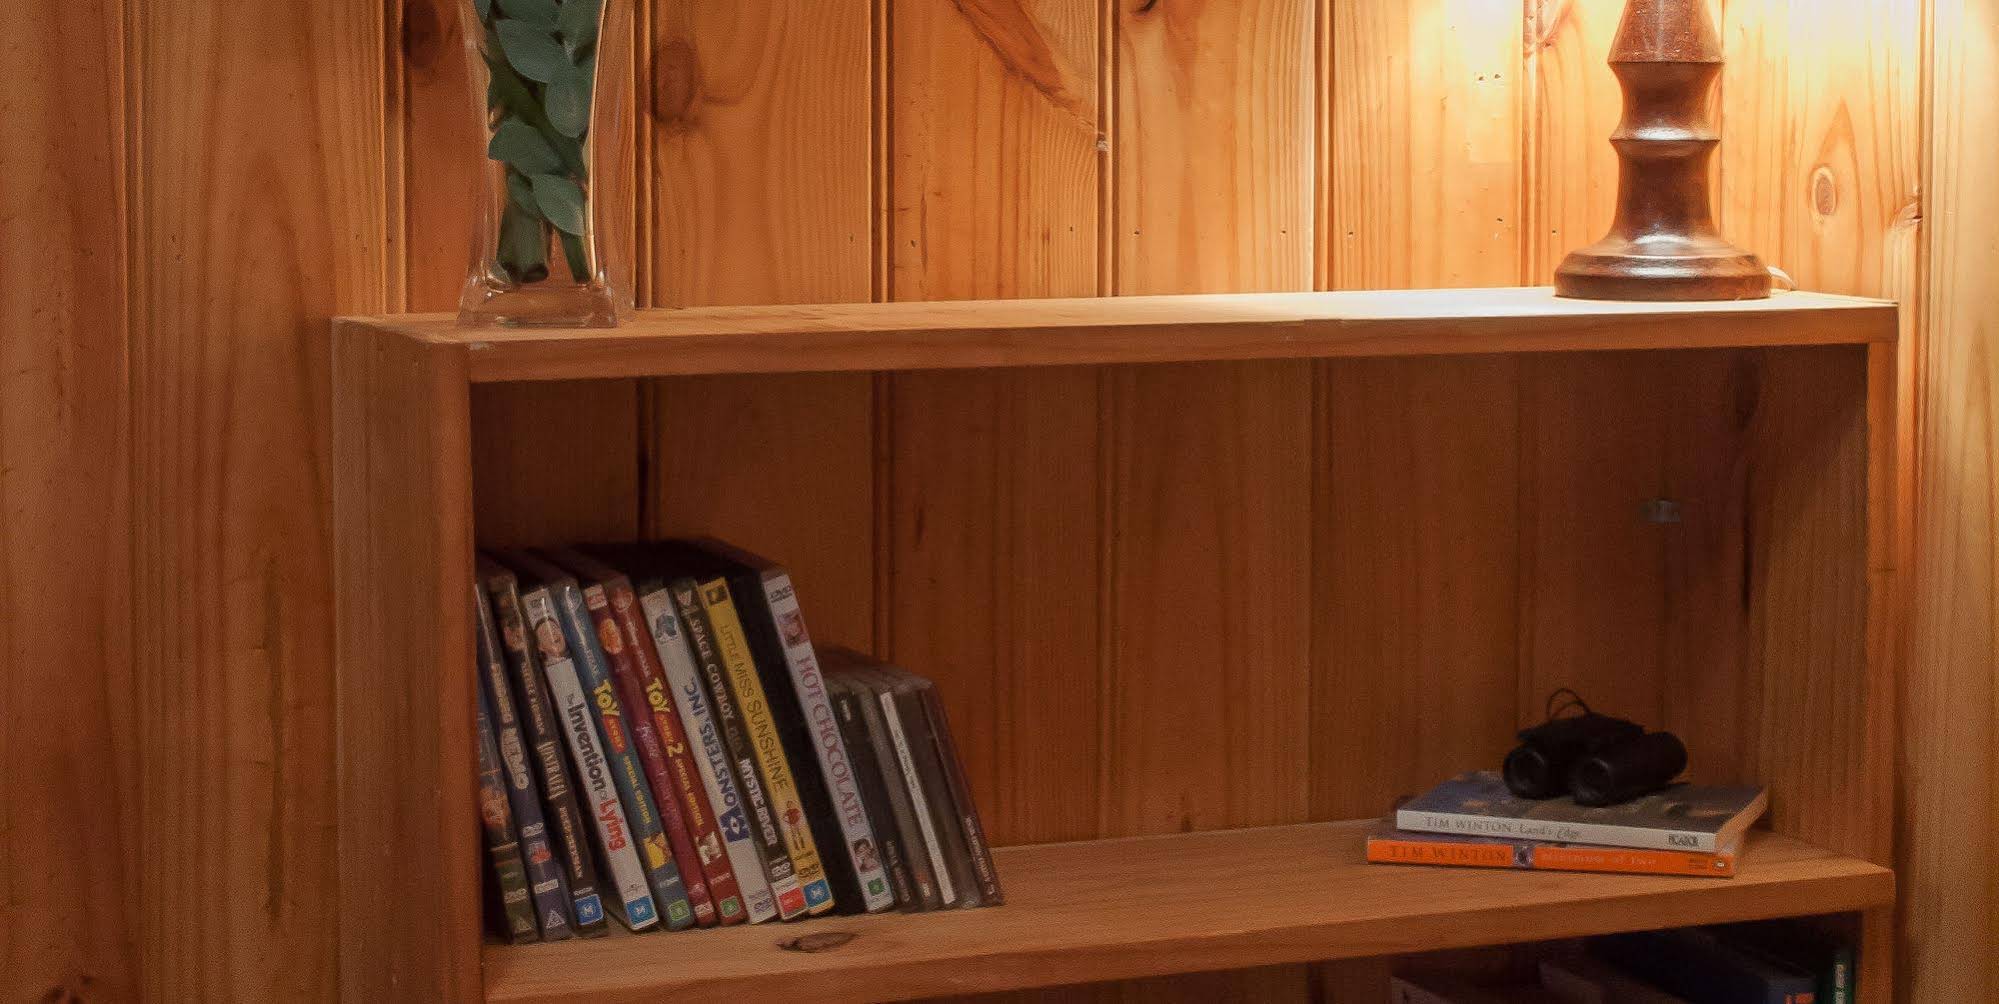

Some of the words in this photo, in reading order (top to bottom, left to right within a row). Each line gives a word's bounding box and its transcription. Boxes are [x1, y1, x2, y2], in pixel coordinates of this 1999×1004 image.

[594, 678, 621, 719] TOY
[643, 677, 669, 717] TOY
[665, 741, 684, 757] 2
[682, 679, 701, 717] INC.
[692, 618, 714, 657] SPACE
[742, 757, 765, 806] MYSTIC
[758, 805, 780, 844] RIVER
[721, 623, 740, 658] LITTLE
[735, 661, 756, 697] MISS
[747, 699, 790, 792] SUNSHINE
[571, 702, 606, 790] Invention
[600, 798, 631, 849] Lying
[797, 657, 820, 698] HOT
[812, 702, 864, 828] CHOCOLATE
[1390, 845, 1424, 859] TIM
[1432, 846, 1507, 861] WINTON
[1424, 816, 1449, 829] TIM
[1455, 819, 1514, 833] WINTON
